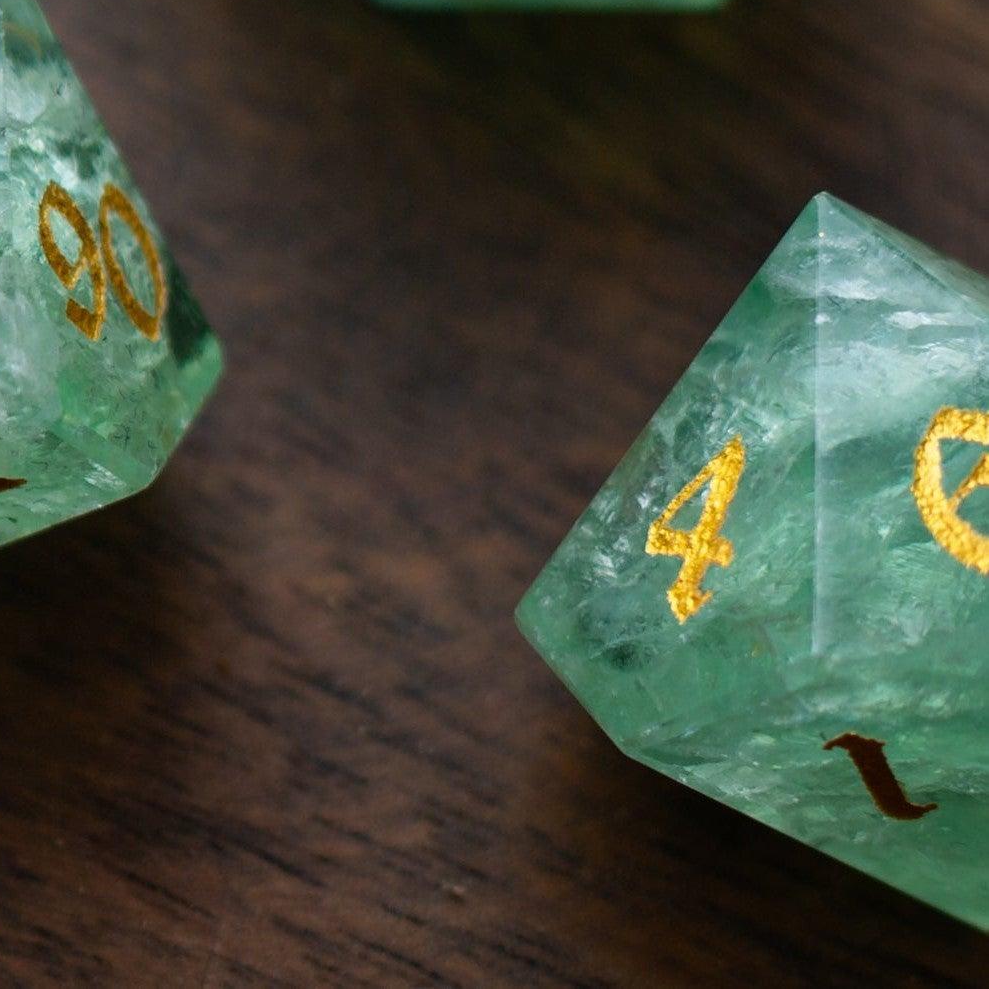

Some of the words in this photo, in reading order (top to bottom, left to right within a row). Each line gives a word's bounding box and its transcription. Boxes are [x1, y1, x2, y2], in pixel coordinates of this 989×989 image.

[39, 180, 167, 342] 90
[645, 435, 748, 624] 4
[822, 732, 938, 820] 1
